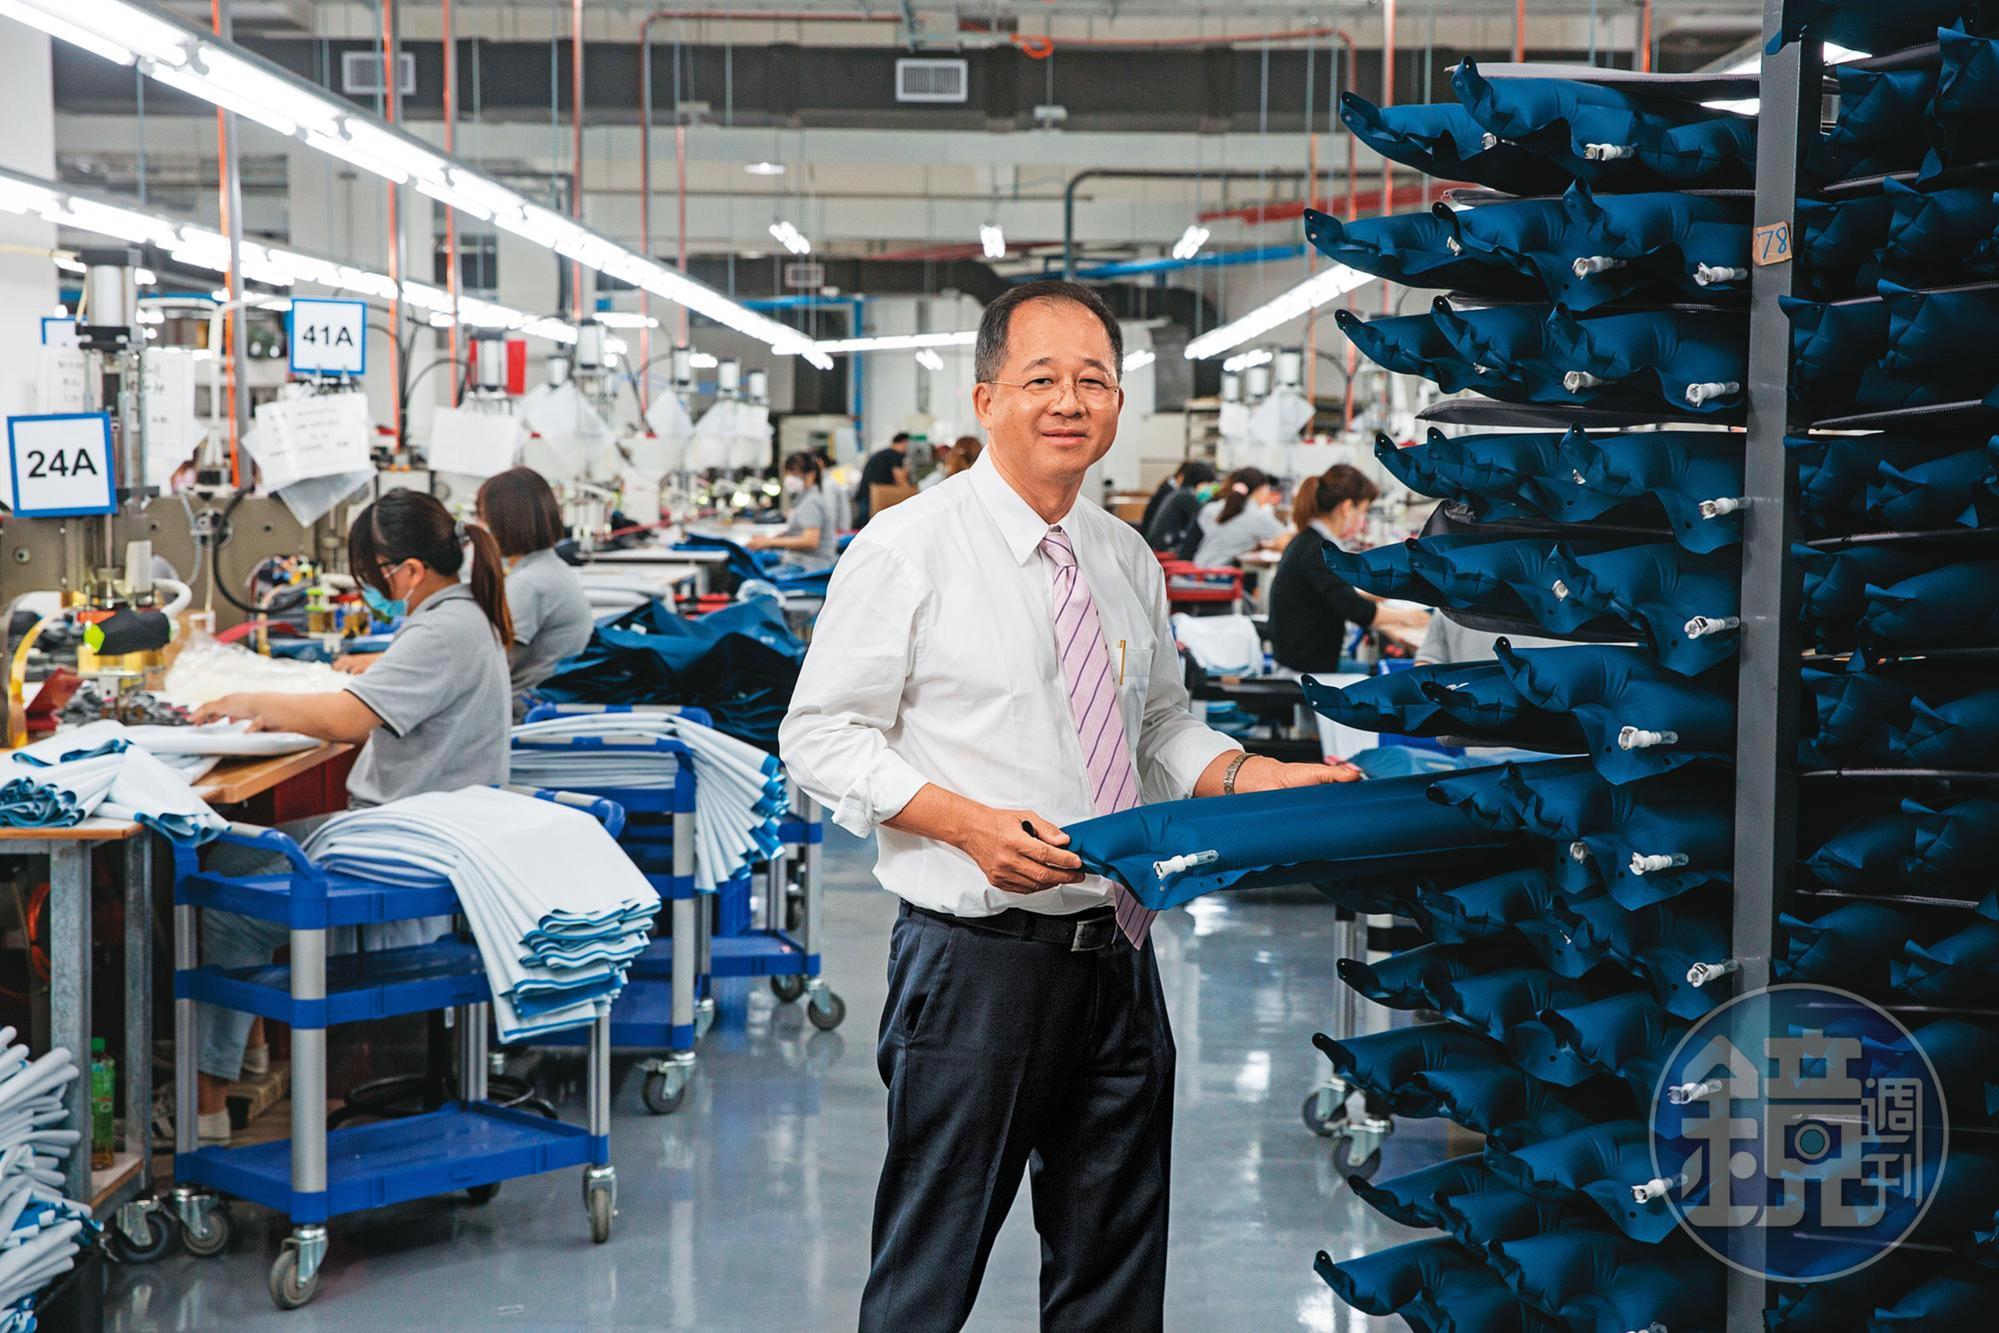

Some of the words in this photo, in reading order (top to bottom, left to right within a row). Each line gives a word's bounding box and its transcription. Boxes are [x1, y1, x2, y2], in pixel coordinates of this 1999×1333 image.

[1757, 226, 1788, 260] 78
[302, 324, 354, 347] 41A
[27, 448, 98, 478] 24A
